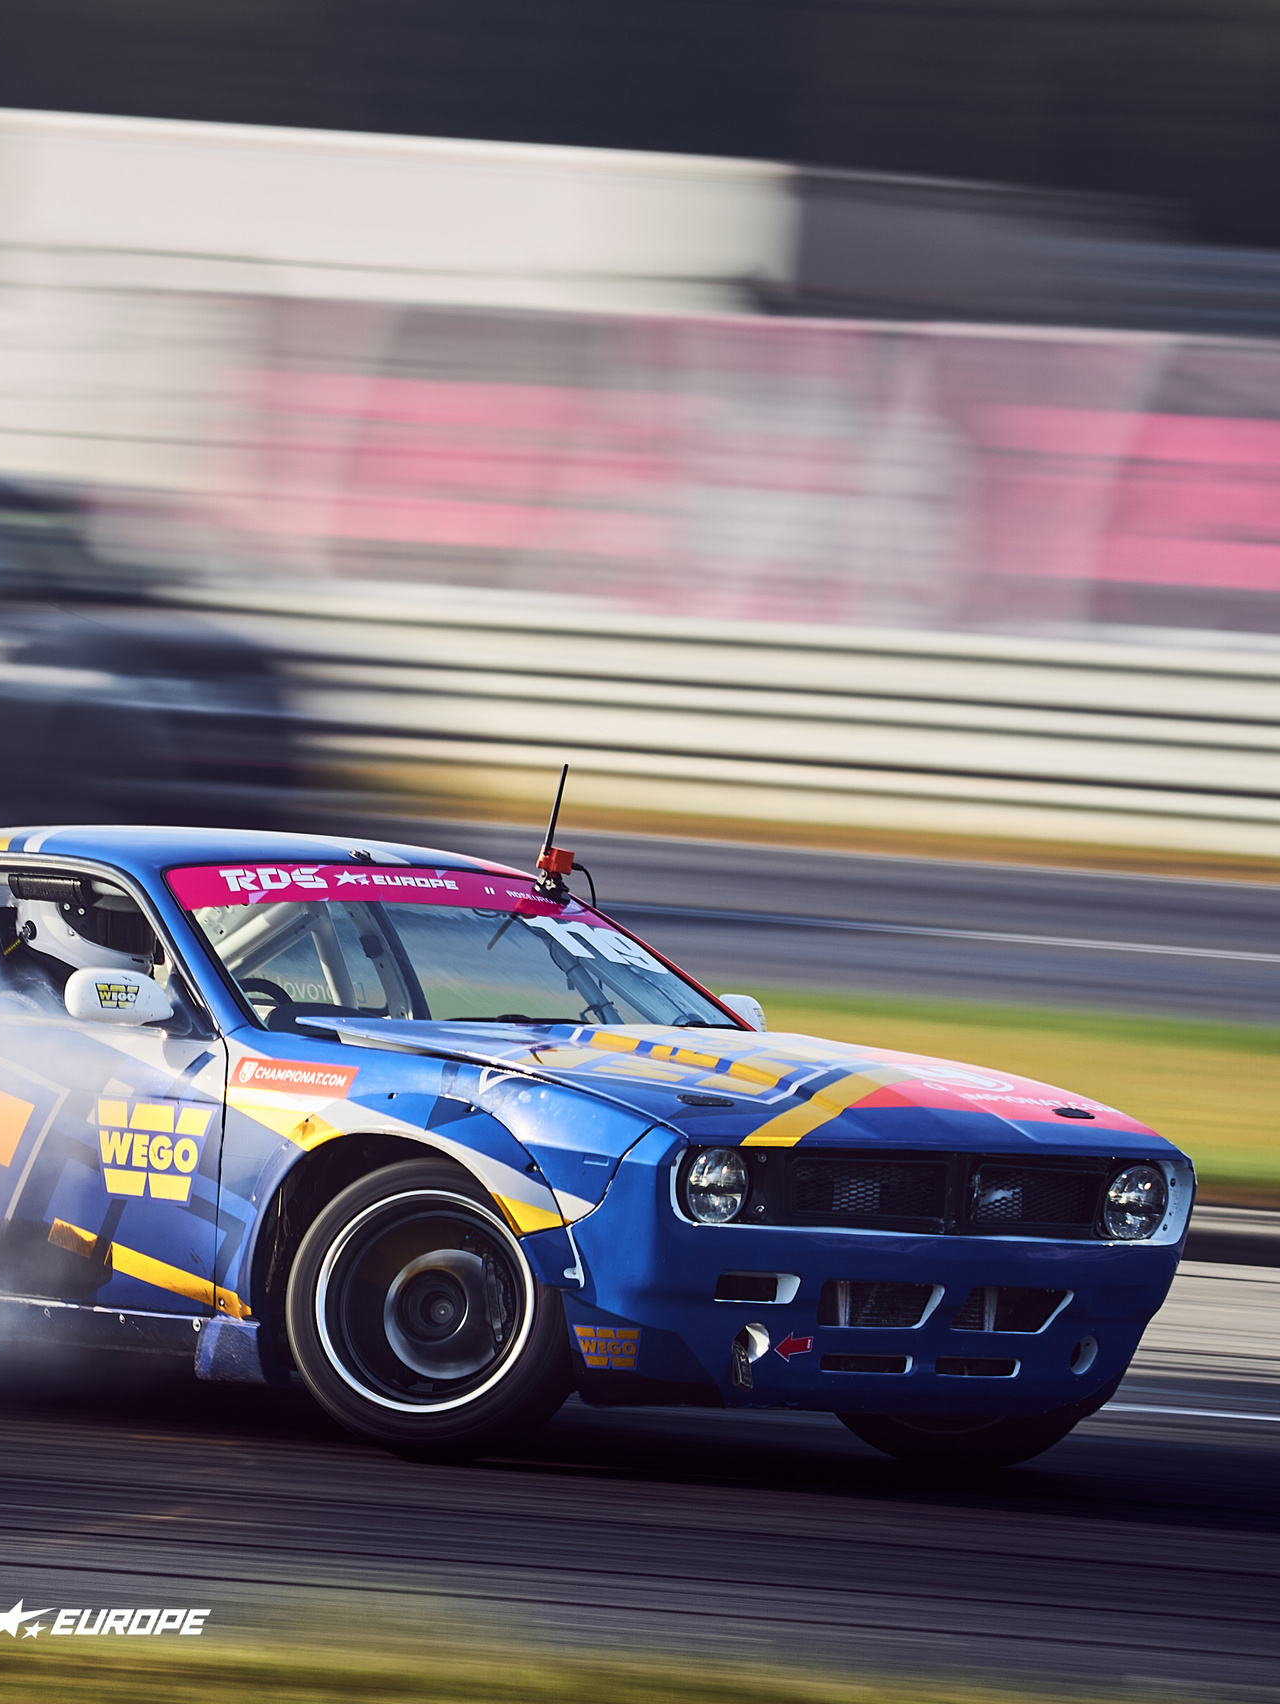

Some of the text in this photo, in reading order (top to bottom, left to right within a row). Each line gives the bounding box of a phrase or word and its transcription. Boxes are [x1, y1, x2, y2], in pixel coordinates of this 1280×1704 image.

[219, 868, 460, 892] RDS EUROPE
[99, 990, 137, 1002] WEGO
[254, 1065, 348, 1088] CHAMPIONAT.COM
[99, 1130, 199, 1174] WEGO
[579, 1338, 637, 1355] WEGO
